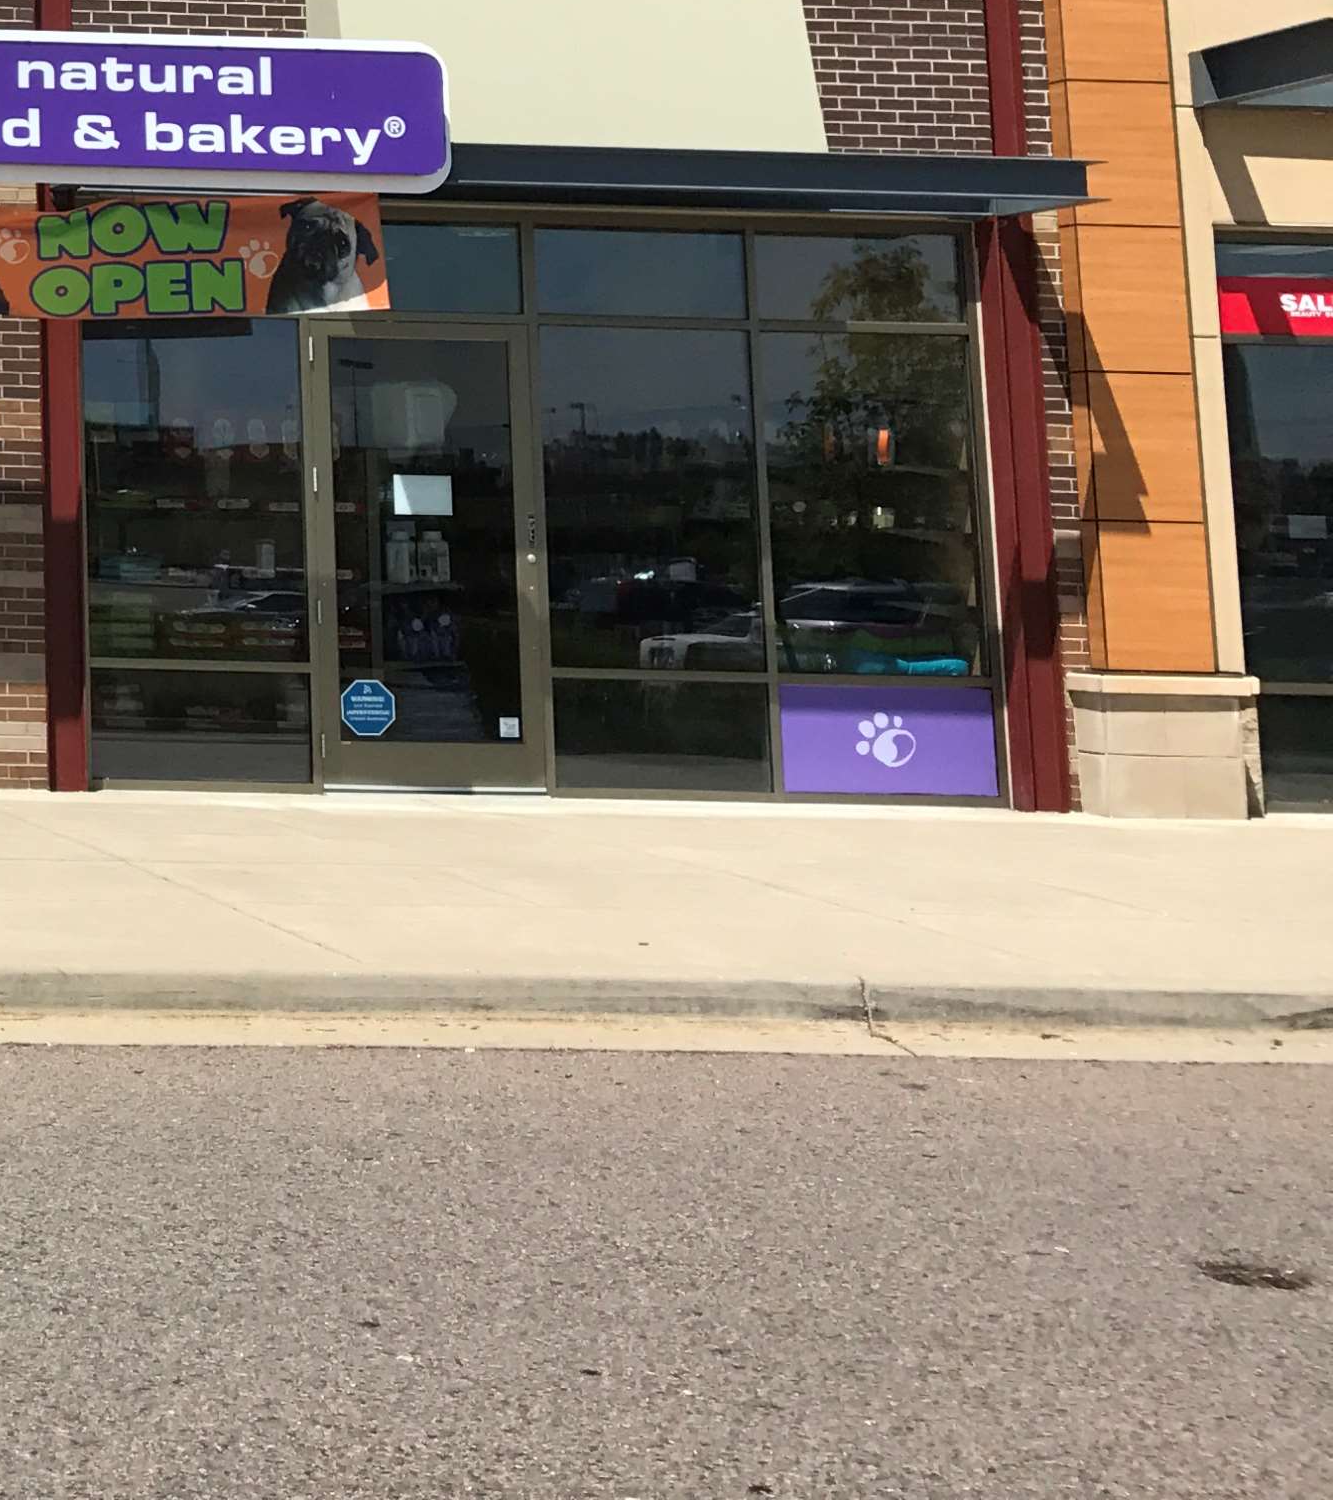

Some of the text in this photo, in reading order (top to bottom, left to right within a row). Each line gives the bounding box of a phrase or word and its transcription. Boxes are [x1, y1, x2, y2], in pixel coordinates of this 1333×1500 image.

[17, 56, 273, 96] natural
[73, 114, 121, 150] &
[35, 200, 229, 261] NOW
[30, 258, 245, 316] OPEN
[1279, 293, 1333, 312] SAL
